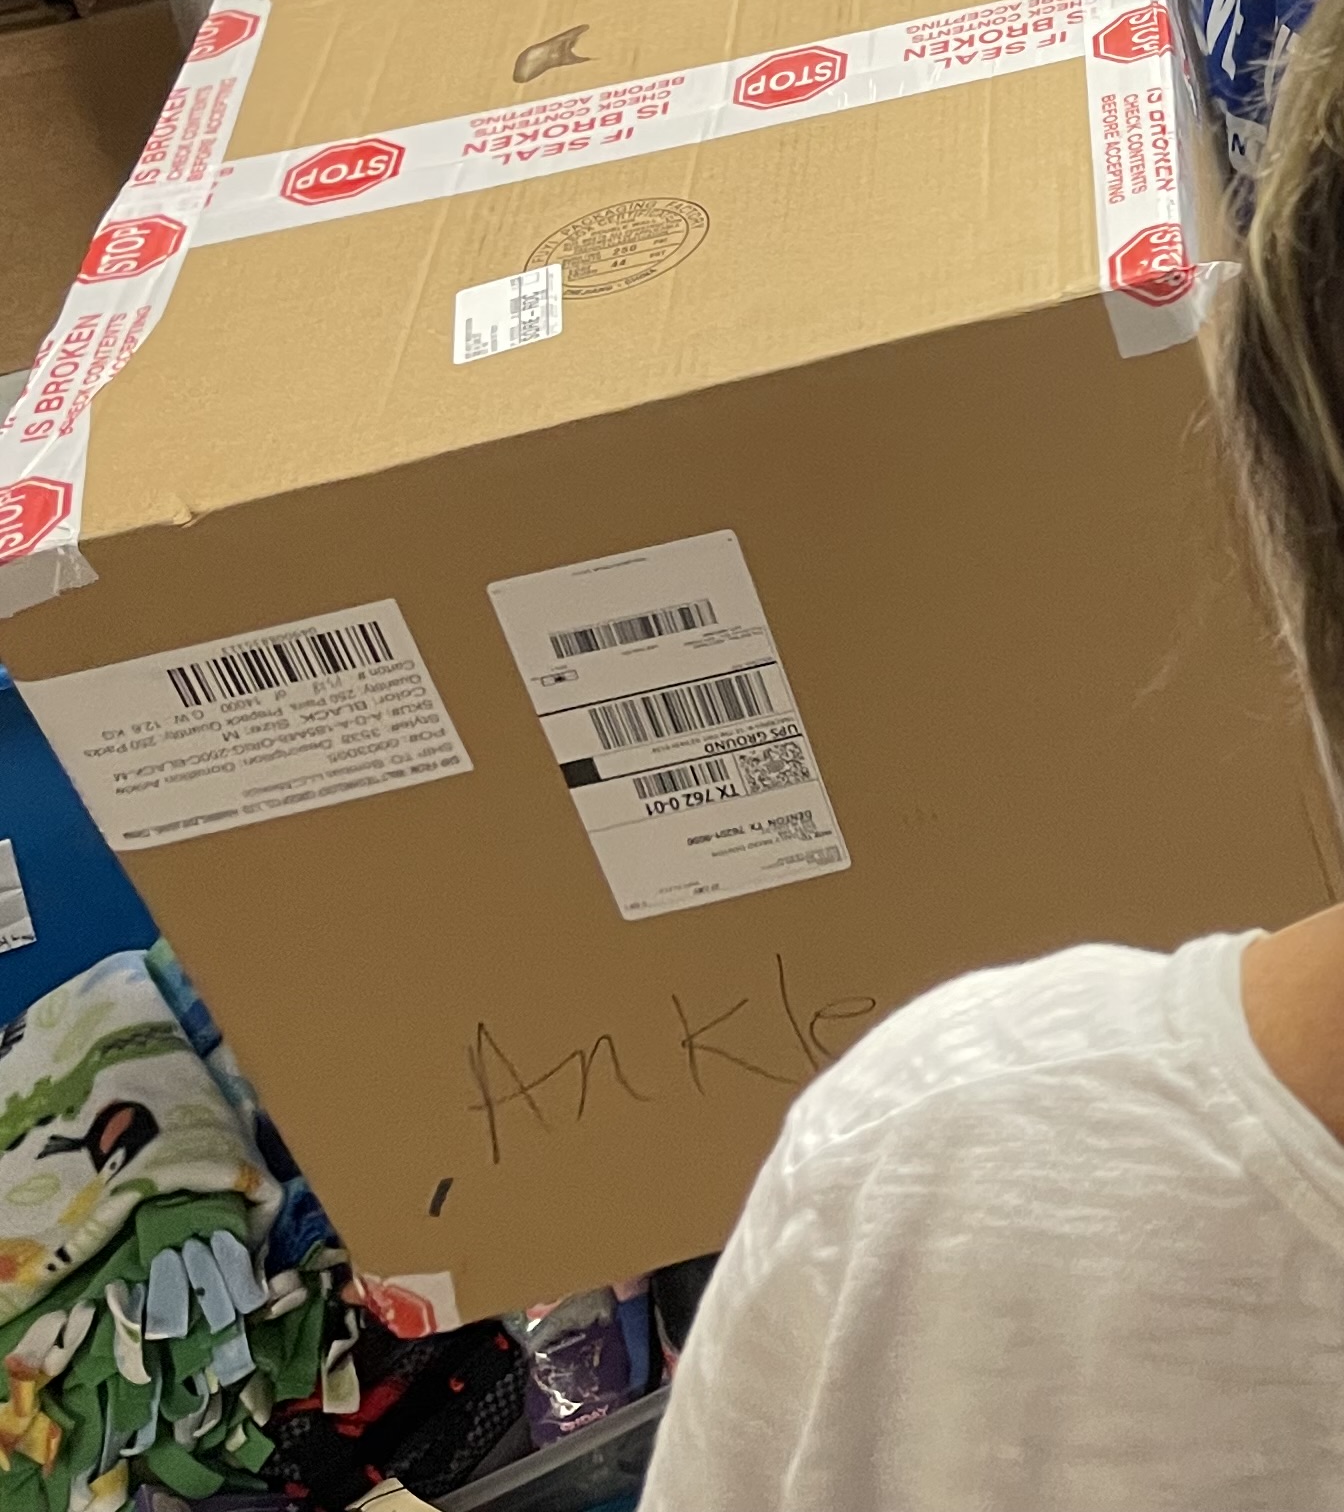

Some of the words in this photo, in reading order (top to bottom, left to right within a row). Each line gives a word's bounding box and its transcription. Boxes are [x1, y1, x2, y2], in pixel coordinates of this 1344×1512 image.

[905, 1, 1022, 35] ACCEPTING
[911, 12, 1022, 44] CONTENTS
[903, 17, 1054, 63] BROKEN
[934, 41, 1028, 69] SEAL
[1037, 31, 1067, 50] IF
[600, 75, 686, 102] BEFORE
[747, 60, 833, 98] STOP
[469, 95, 591, 128] ACCEPTING
[597, 89, 672, 111] CHECK
[636, 101, 670, 122] IS
[1123, 93, 1144, 136] CHECK
[142, 87, 190, 165] BROKEN
[473, 106, 591, 138] CONTENTS
[1101, 93, 1119, 140] BEFORE
[463, 110, 624, 157] BROKEN
[600, 126, 635, 145] IF
[492, 134, 591, 166] SEAL
[1126, 134, 1149, 196] CONTENTS
[131, 168, 161, 187] IS
[296, 154, 388, 190] STOP
[1103, 140, 1126, 205] ACCEPTING
[97, 225, 151, 275] STOP
[35, 313, 104, 414] BROKEN
[82, 313, 127, 392] CONTENTS
[20, 419, 55, 444] IS
[299, 700, 368, 724] BLACK
[221, 729, 241, 742] M
[701, 728, 769, 755] GROUND
[767, 721, 799, 739] UPS
[642, 794, 682, 816] 0-01
[681, 787, 715, 808] 762
[715, 781, 740, 800] TX
